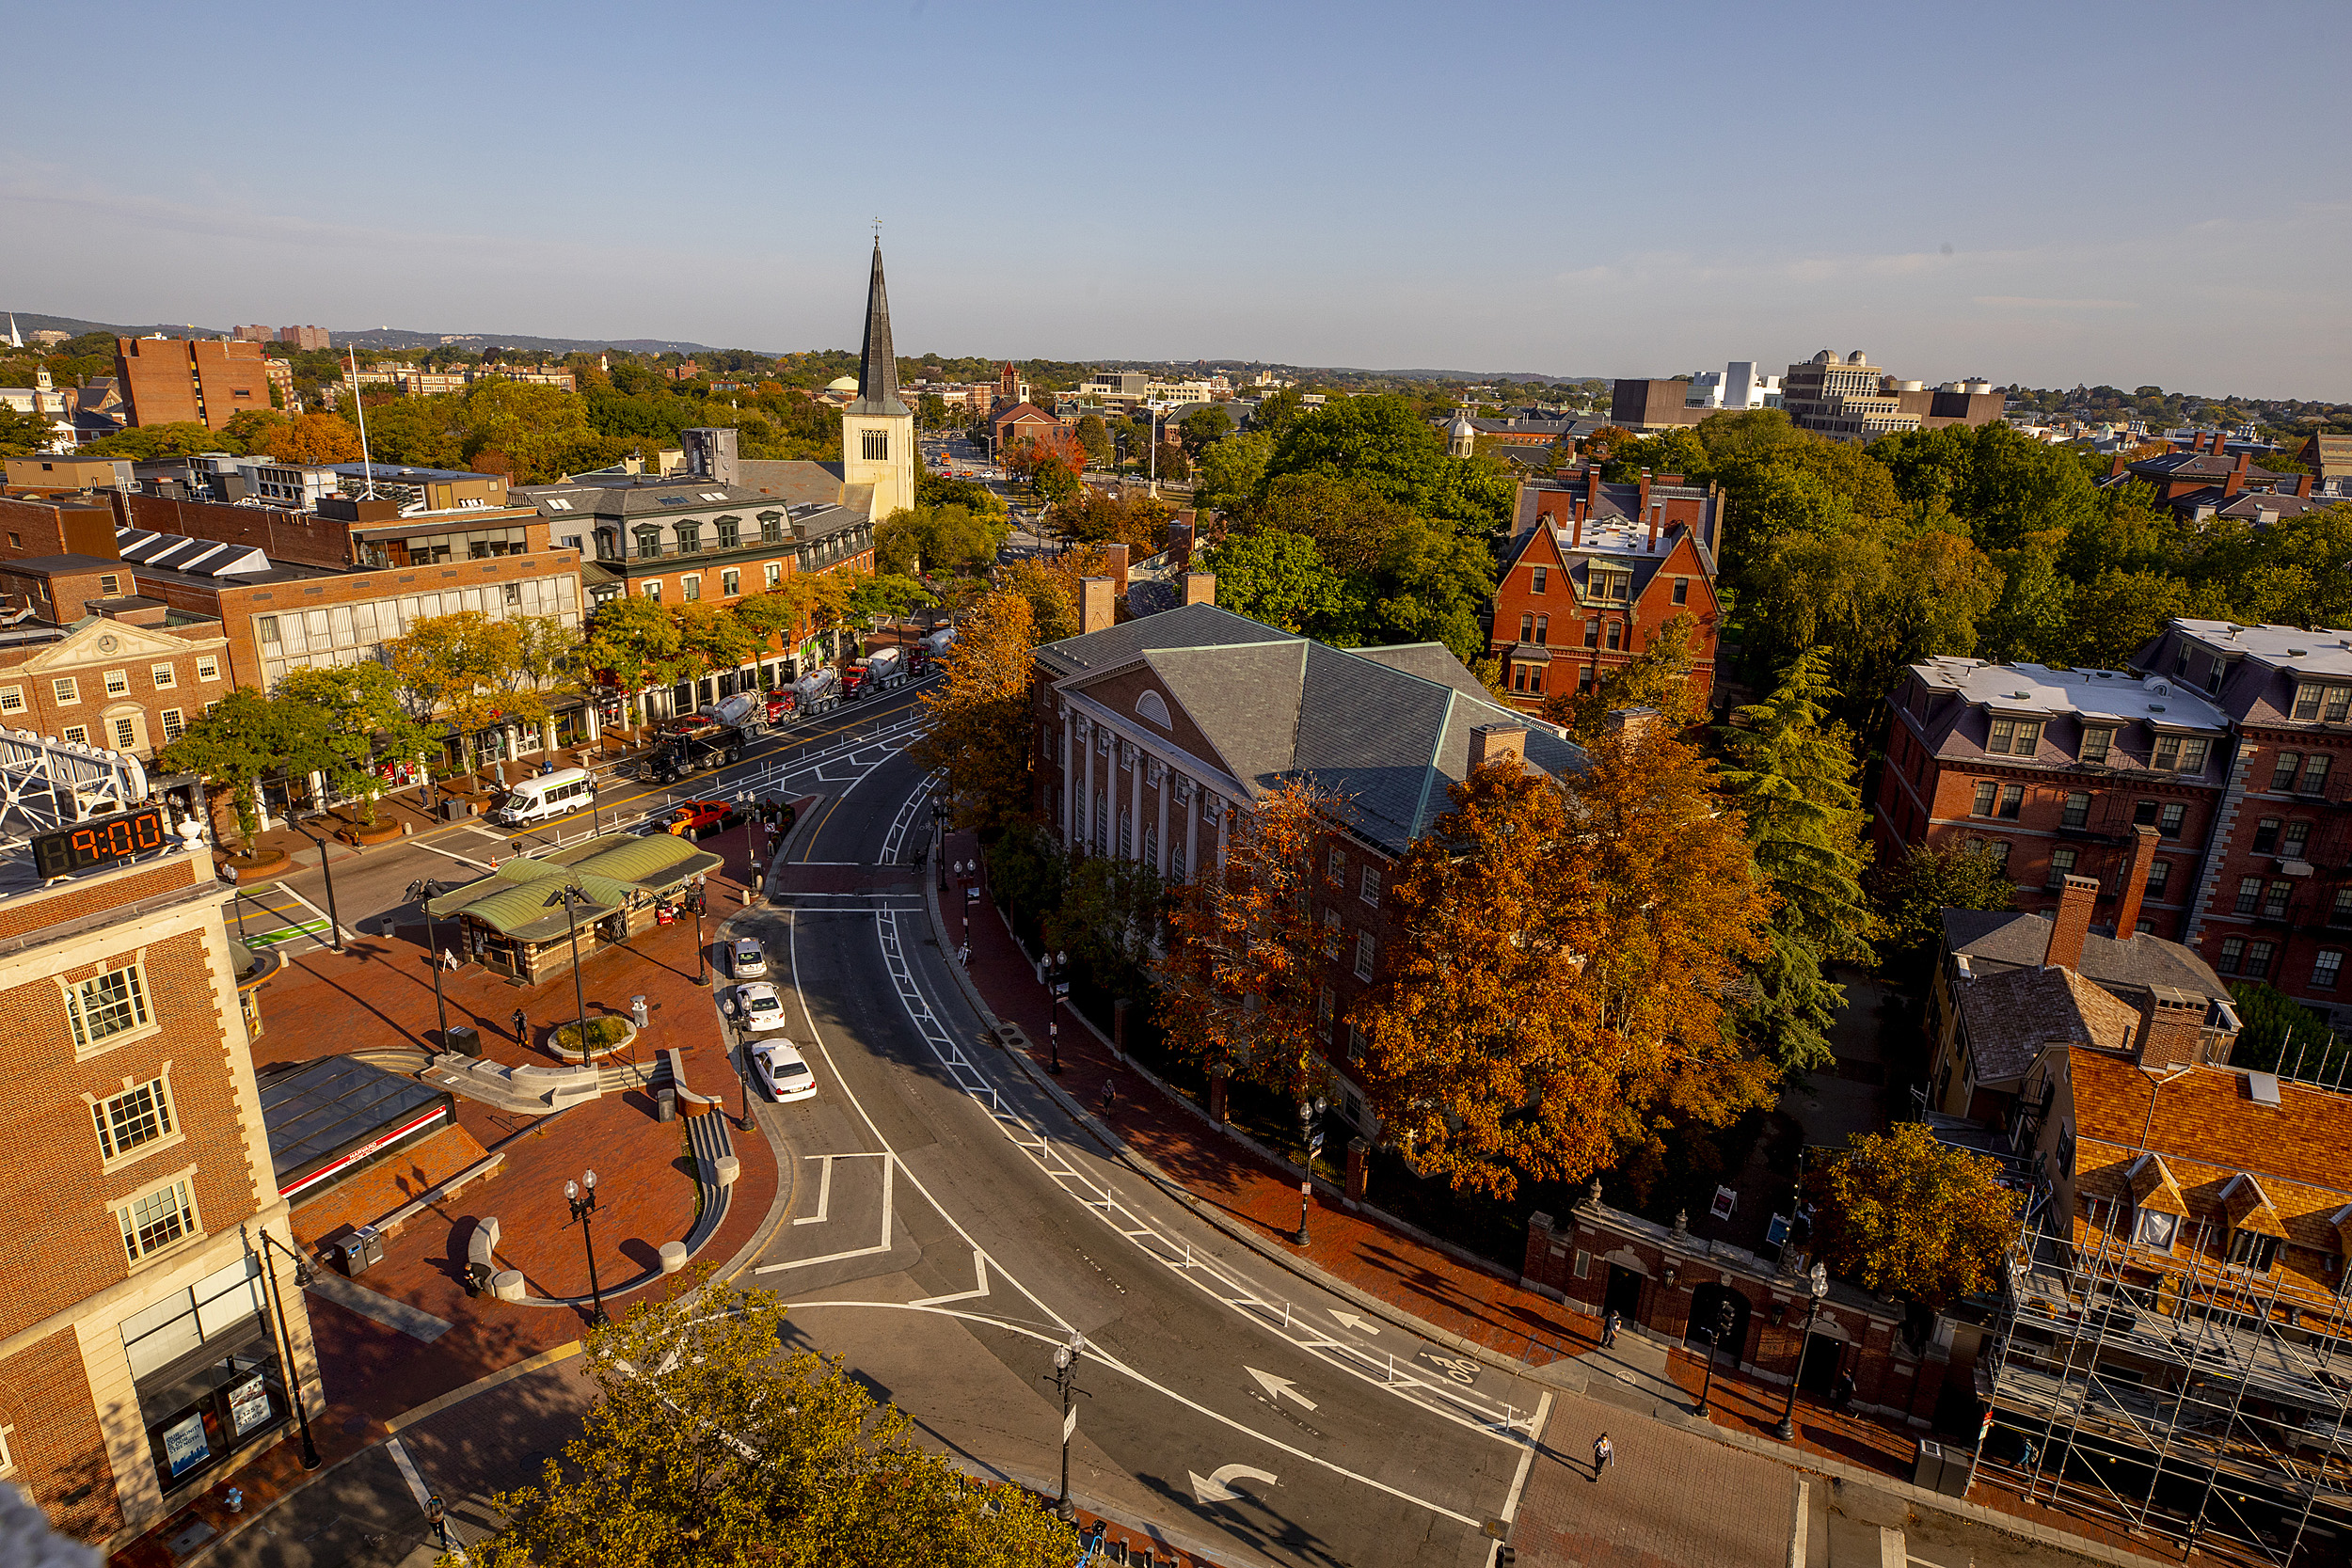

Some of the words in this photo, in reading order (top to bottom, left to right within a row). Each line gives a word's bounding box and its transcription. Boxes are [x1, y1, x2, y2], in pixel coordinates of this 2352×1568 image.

[72, 814, 161, 860] 9:00
[349, 1142, 377, 1160] HARVARD
[167, 1423, 201, 1448] COMMUNITY
[167, 1432, 180, 1443] OUR
[169, 1433, 201, 1455] STRENGTH.
[175, 1436, 188, 1447] OUR
